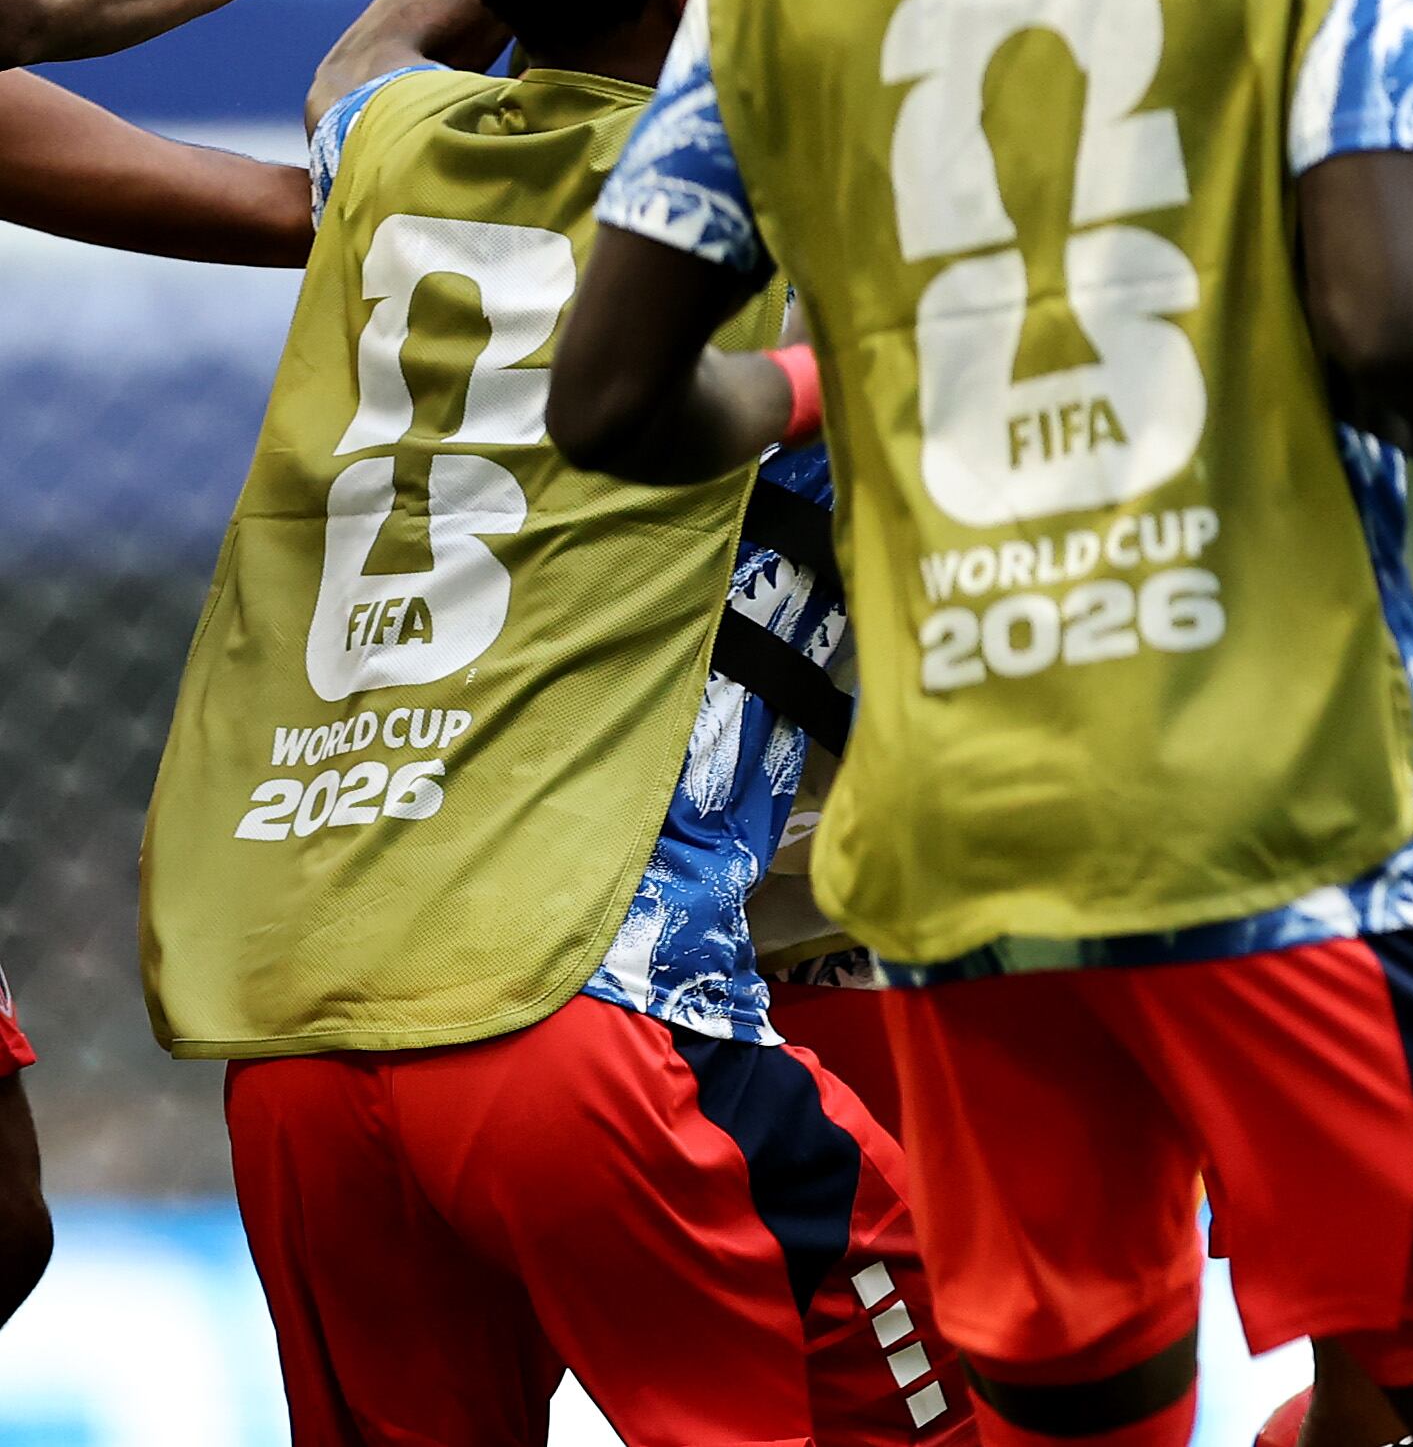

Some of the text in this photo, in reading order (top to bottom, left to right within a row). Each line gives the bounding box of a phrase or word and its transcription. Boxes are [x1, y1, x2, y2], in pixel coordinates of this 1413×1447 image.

[1009, 397, 1129, 471] FIFA
[920, 507, 1220, 603] WORLD CUP
[345, 596, 434, 652] FIFA
[920, 570, 1226, 692] 2026
[270, 706, 473, 768] WORLD CUP
[233, 757, 447, 843] 2026
